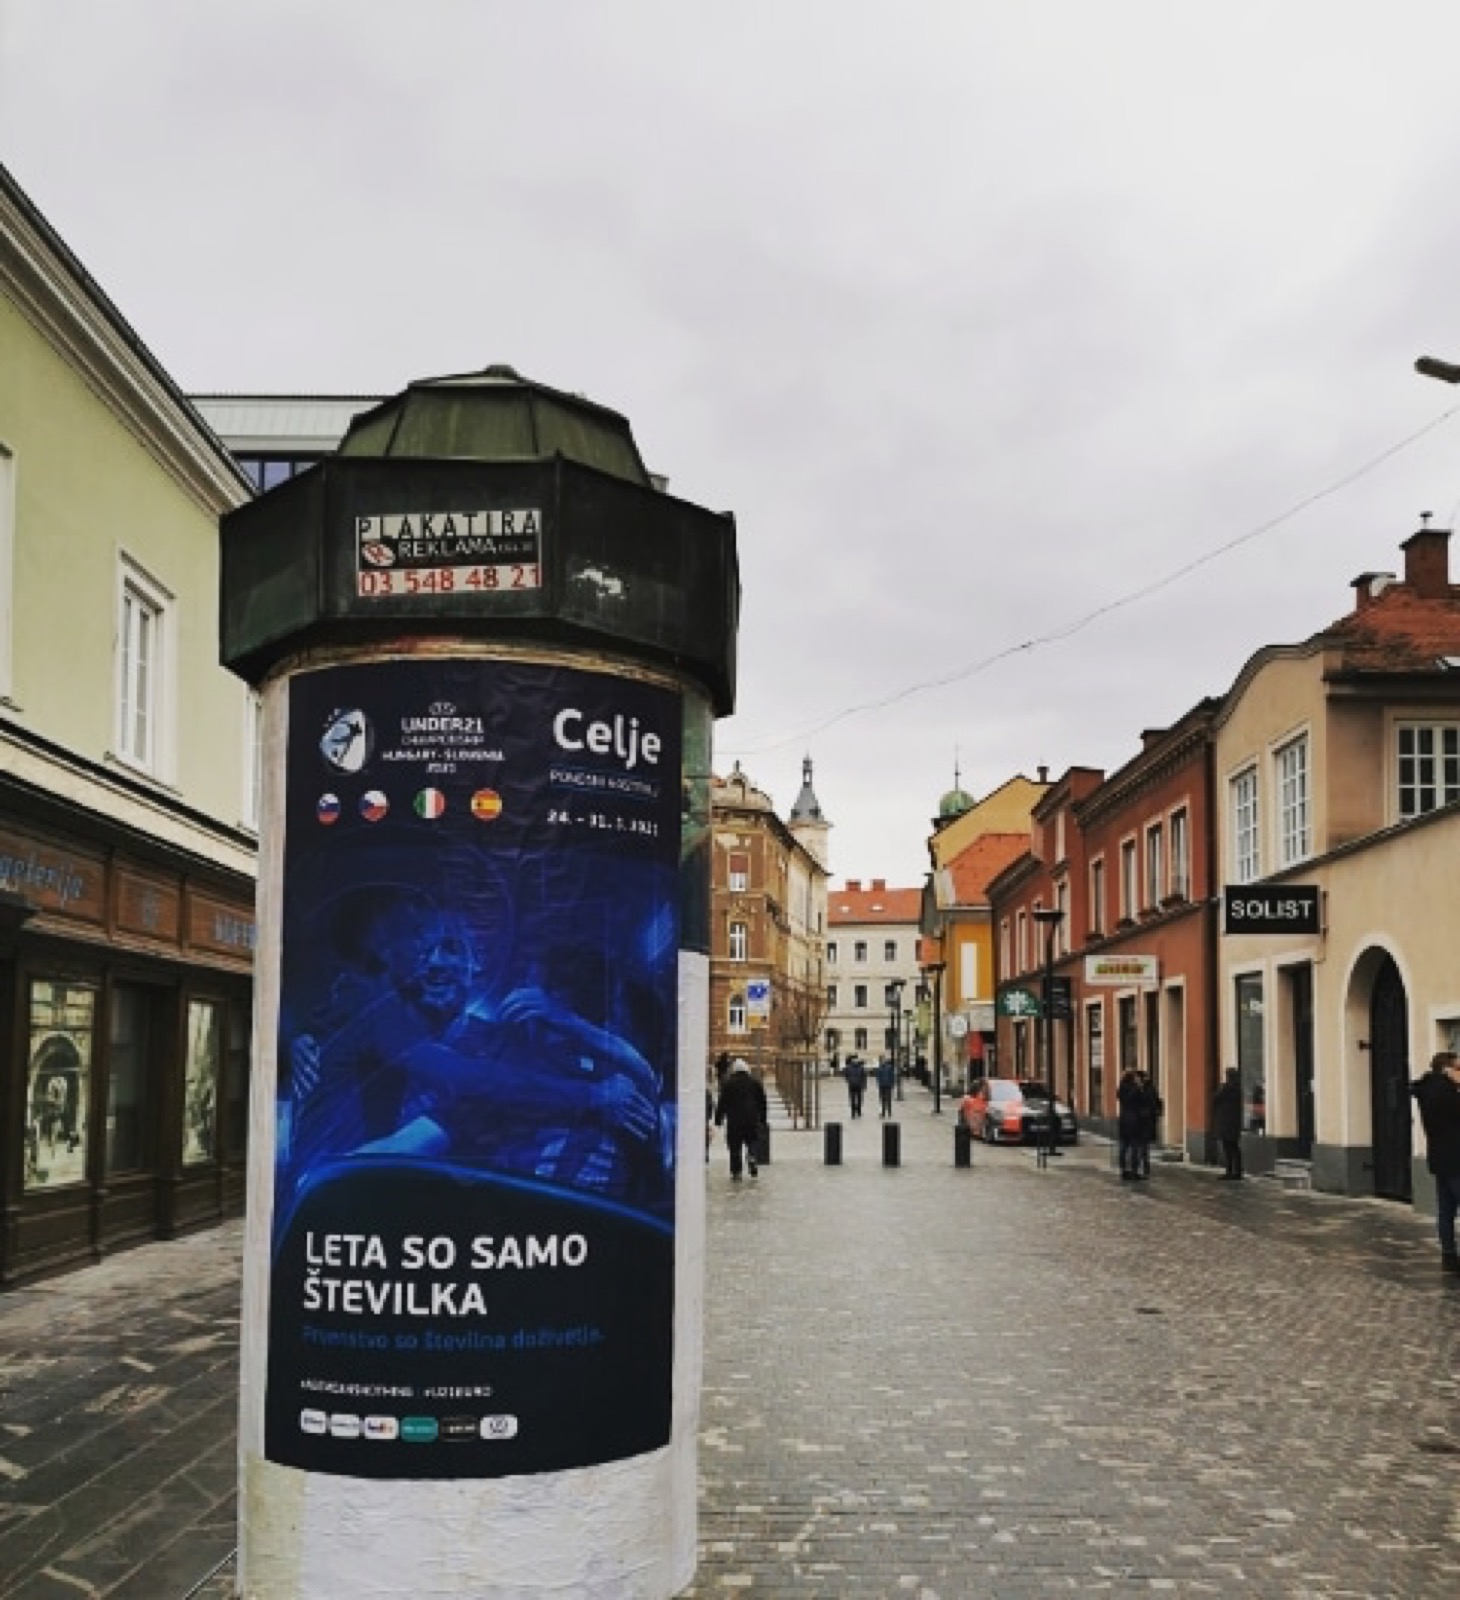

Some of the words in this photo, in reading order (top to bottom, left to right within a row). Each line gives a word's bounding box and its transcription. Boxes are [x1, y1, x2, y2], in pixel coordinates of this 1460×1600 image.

[358, 511, 540, 543] PLAKATIRA
[400, 538, 497, 558] REKLAMA
[361, 571, 392, 594] 03
[405, 569, 454, 592] 548
[466, 567, 499, 590] 48
[511, 565, 540, 588] 21
[553, 708, 661, 770] Celje
[1231, 900, 1312, 919] SOLIST
[306, 1231, 387, 1269] LETA
[401, 1236, 456, 1269] SO
[471, 1234, 588, 1269] SAMO
[303, 1267, 487, 1315] ŠTEVILKA
